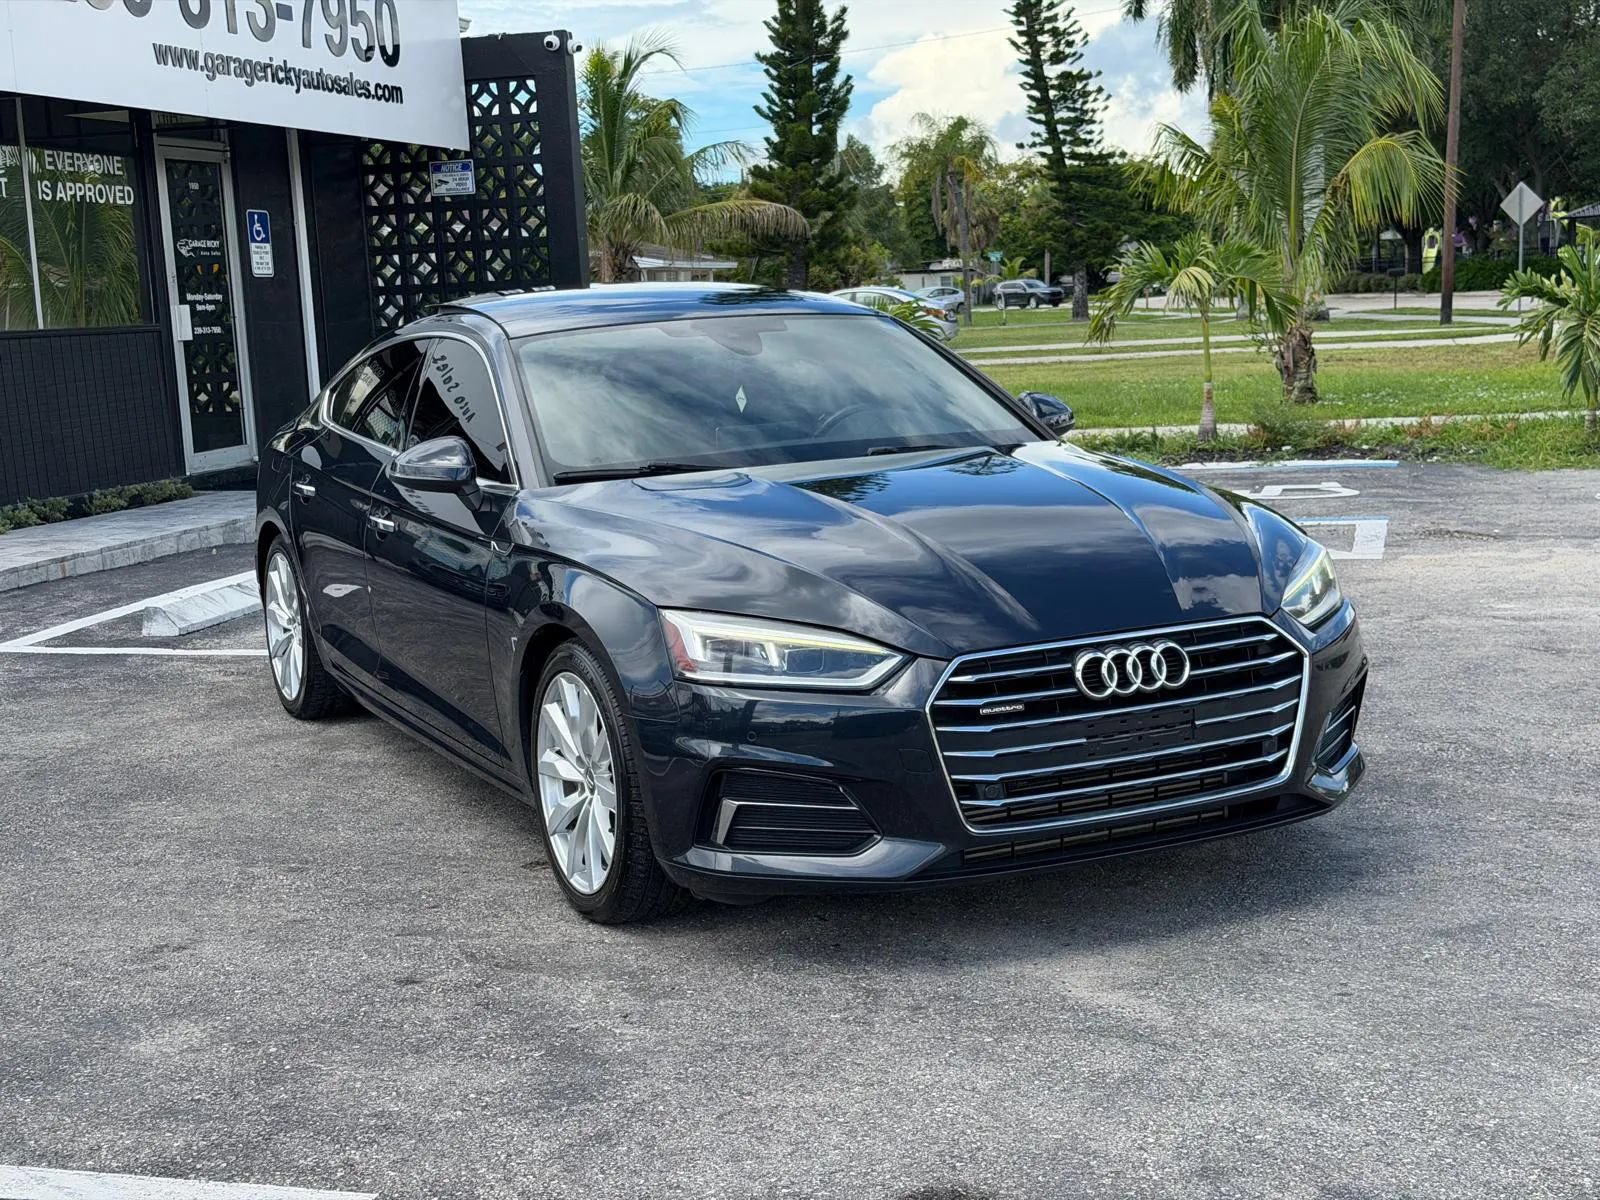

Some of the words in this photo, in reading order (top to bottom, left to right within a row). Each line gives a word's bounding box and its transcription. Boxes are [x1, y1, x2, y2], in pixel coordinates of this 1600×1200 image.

[152, 42, 404, 104] www.garagerickyautosales.com
[44, 149, 124, 175] EVERYONE
[37, 180, 53, 201] IS
[56, 181, 134, 205] APPROVED
